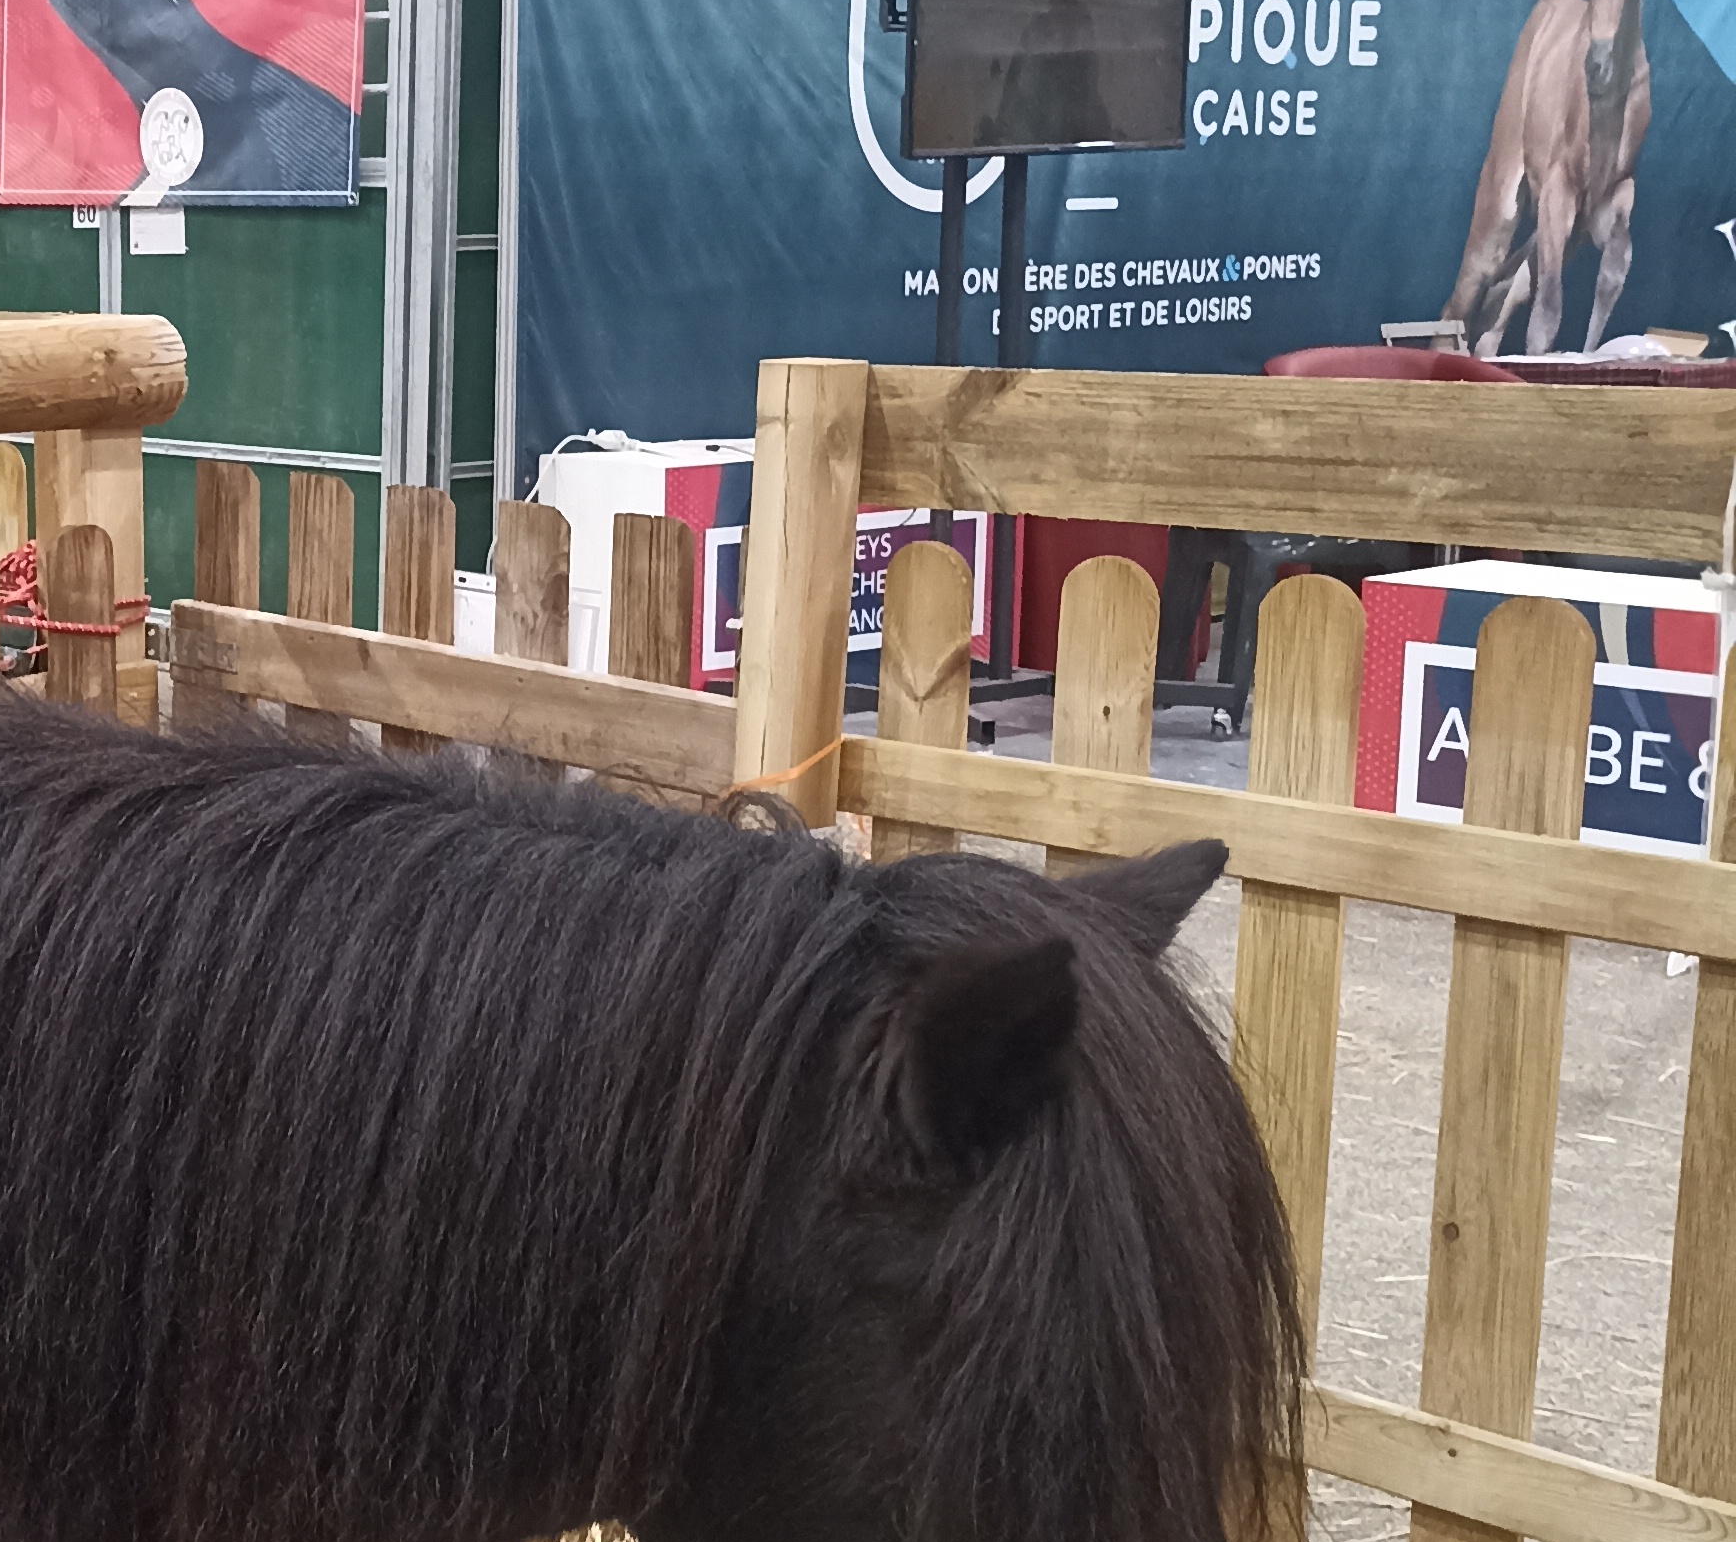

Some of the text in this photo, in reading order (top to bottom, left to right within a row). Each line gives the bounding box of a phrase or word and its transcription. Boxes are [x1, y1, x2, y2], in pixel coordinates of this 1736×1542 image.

[904, 267, 998, 296] MAON
[1024, 259, 1068, 292] ÈRE
[1074, 261, 1116, 290] DES
[1122, 258, 1220, 287] CHEVAUX
[1242, 253, 1321, 281] PONEYS
[1029, 302, 1104, 333] SPORT
[1108, 301, 1137, 328] ET
[1141, 299, 1169, 327] DE
[1174, 295, 1252, 325] LOISIRS
[1426, 707, 1672, 794] ABE
